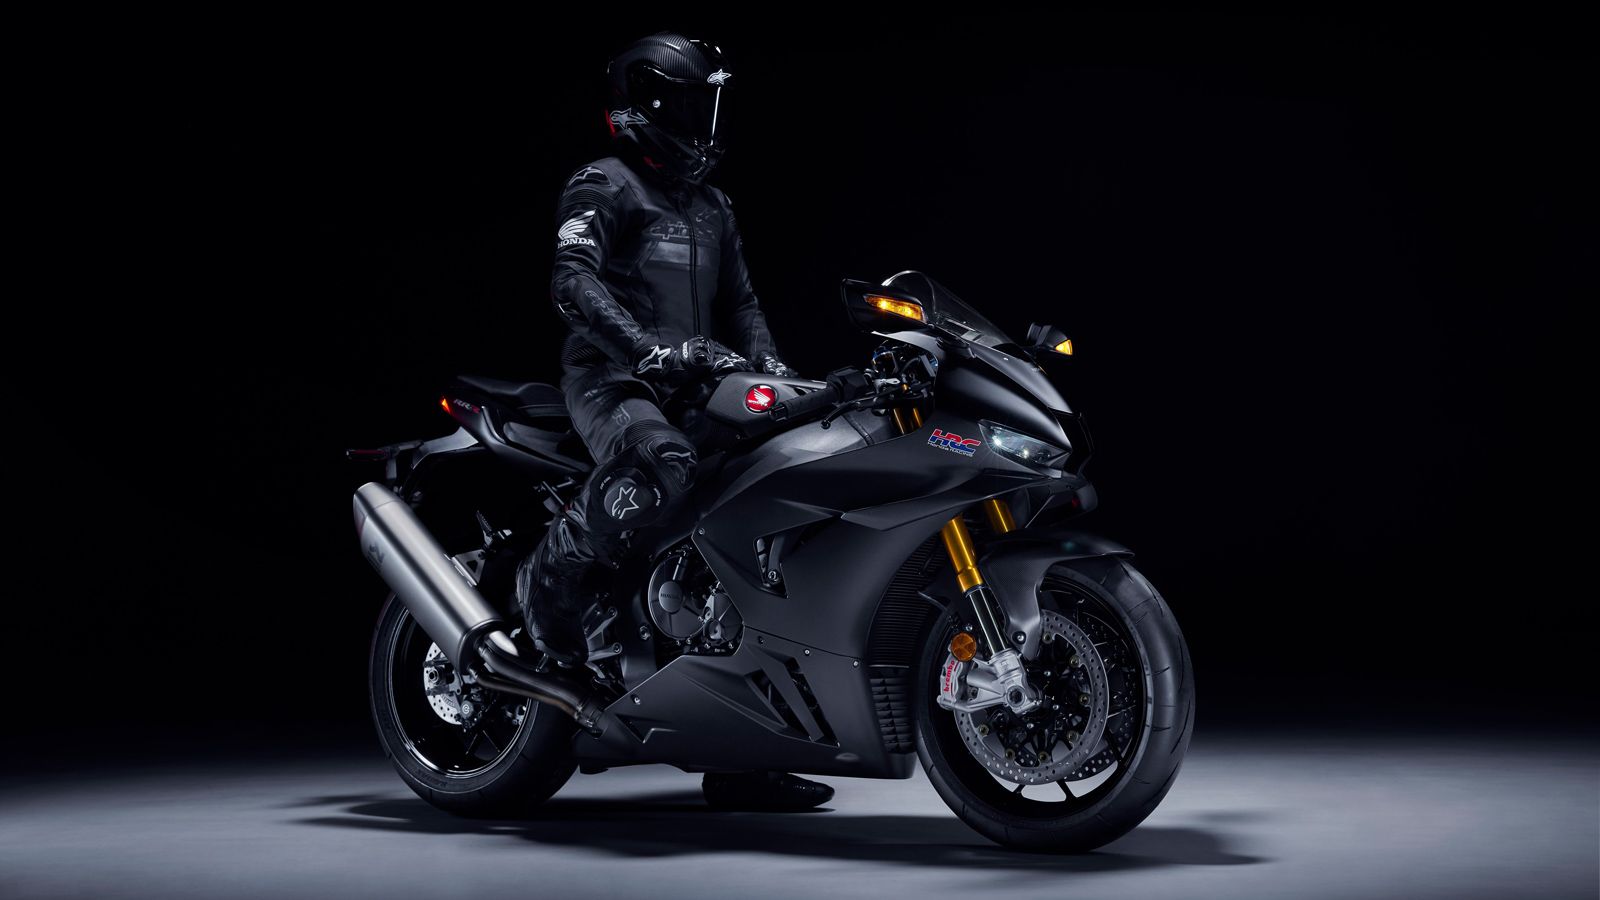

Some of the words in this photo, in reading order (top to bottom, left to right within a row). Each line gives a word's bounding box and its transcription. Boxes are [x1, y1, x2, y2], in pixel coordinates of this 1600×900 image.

[557, 237, 597, 249] HONDA
[928, 429, 981, 454] HRC
[943, 660, 956, 692] brembo
